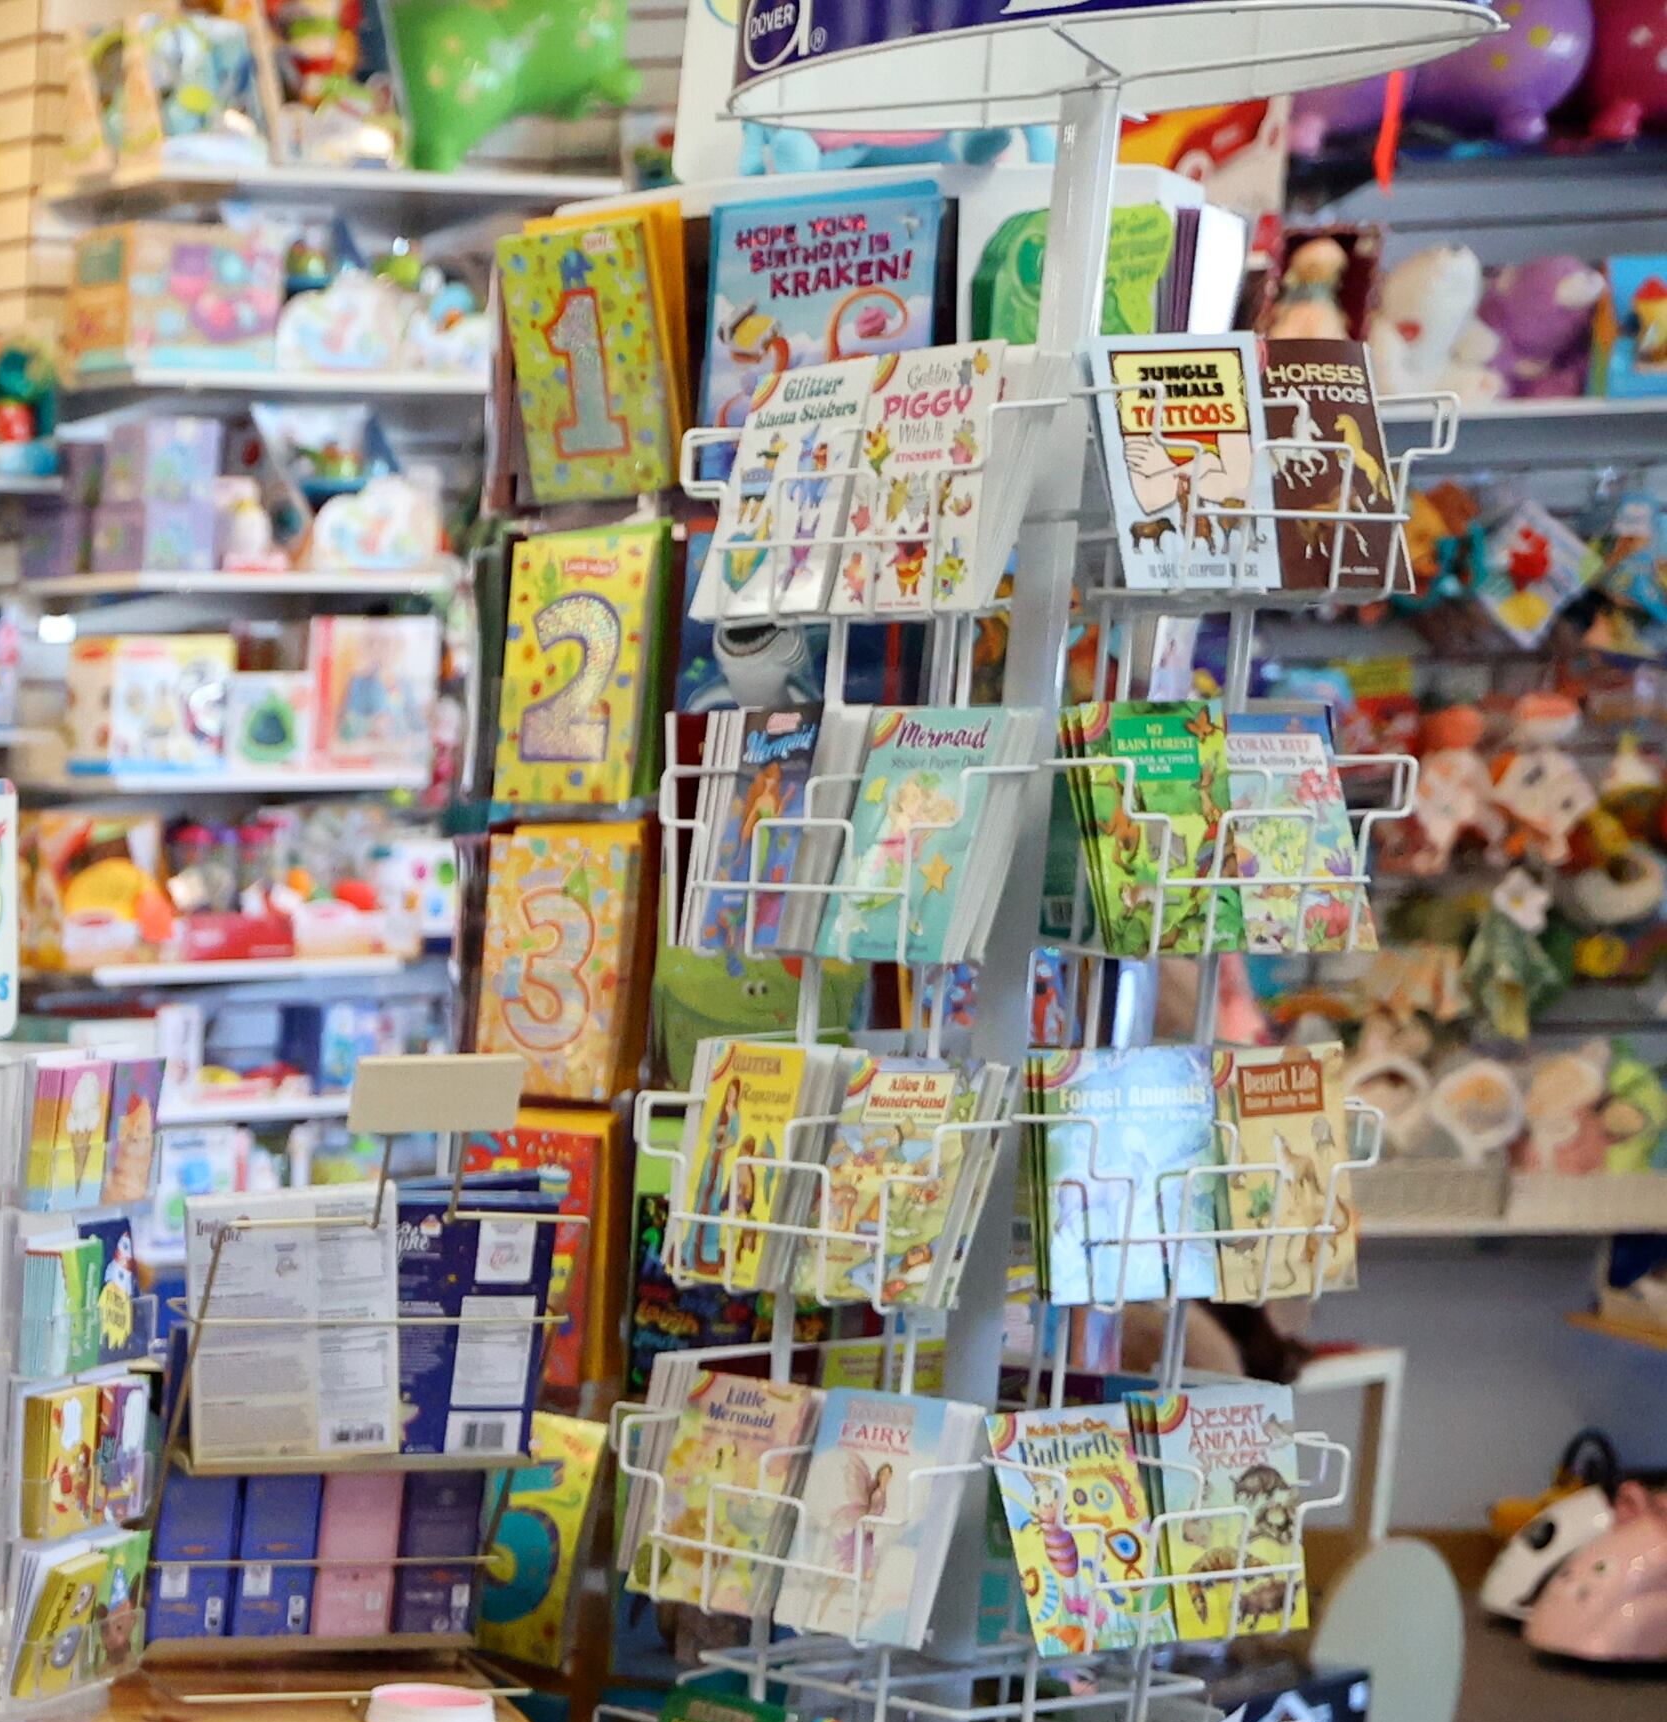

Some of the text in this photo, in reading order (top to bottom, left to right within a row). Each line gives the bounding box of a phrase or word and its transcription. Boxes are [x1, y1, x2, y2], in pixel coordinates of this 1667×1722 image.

[750, 3, 795, 39] DOVER
[736, 214, 867, 250] HOPE YOUR
[750, 232, 890, 273] BIRTHDAY IS
[770, 249, 913, 299] KRAKEN!
[543, 287, 631, 459] 1
[1138, 364, 1219, 381] JUNGLE
[1267, 364, 1365, 385] HORSES
[782, 376, 844, 402] Glitter
[1269, 385, 1368, 405] TATTOOS
[800, 400, 857, 424] Stickers
[883, 386, 973, 421] PIGGY
[518, 591, 621, 763] 2
[897, 719, 992, 749] Mermaid
[1117, 738, 1148, 751] RAIN
[501, 886, 598, 1052] 3
[889, 1076, 920, 1091] Alice
[1243, 1065, 1318, 1094] Desert Life
[870, 1094, 947, 1109] Wonderland
[1059, 1087, 1122, 1110] Forest
[725, 1386, 765, 1408] Little
[706, 1401, 776, 1429] Mermaid
[1189, 1404, 1265, 1428] DESERT
[842, 1423, 912, 1447] FAIRY
[1189, 1427, 1272, 1449] ANIMALS
[1017, 1432, 1119, 1466] Butterfly
